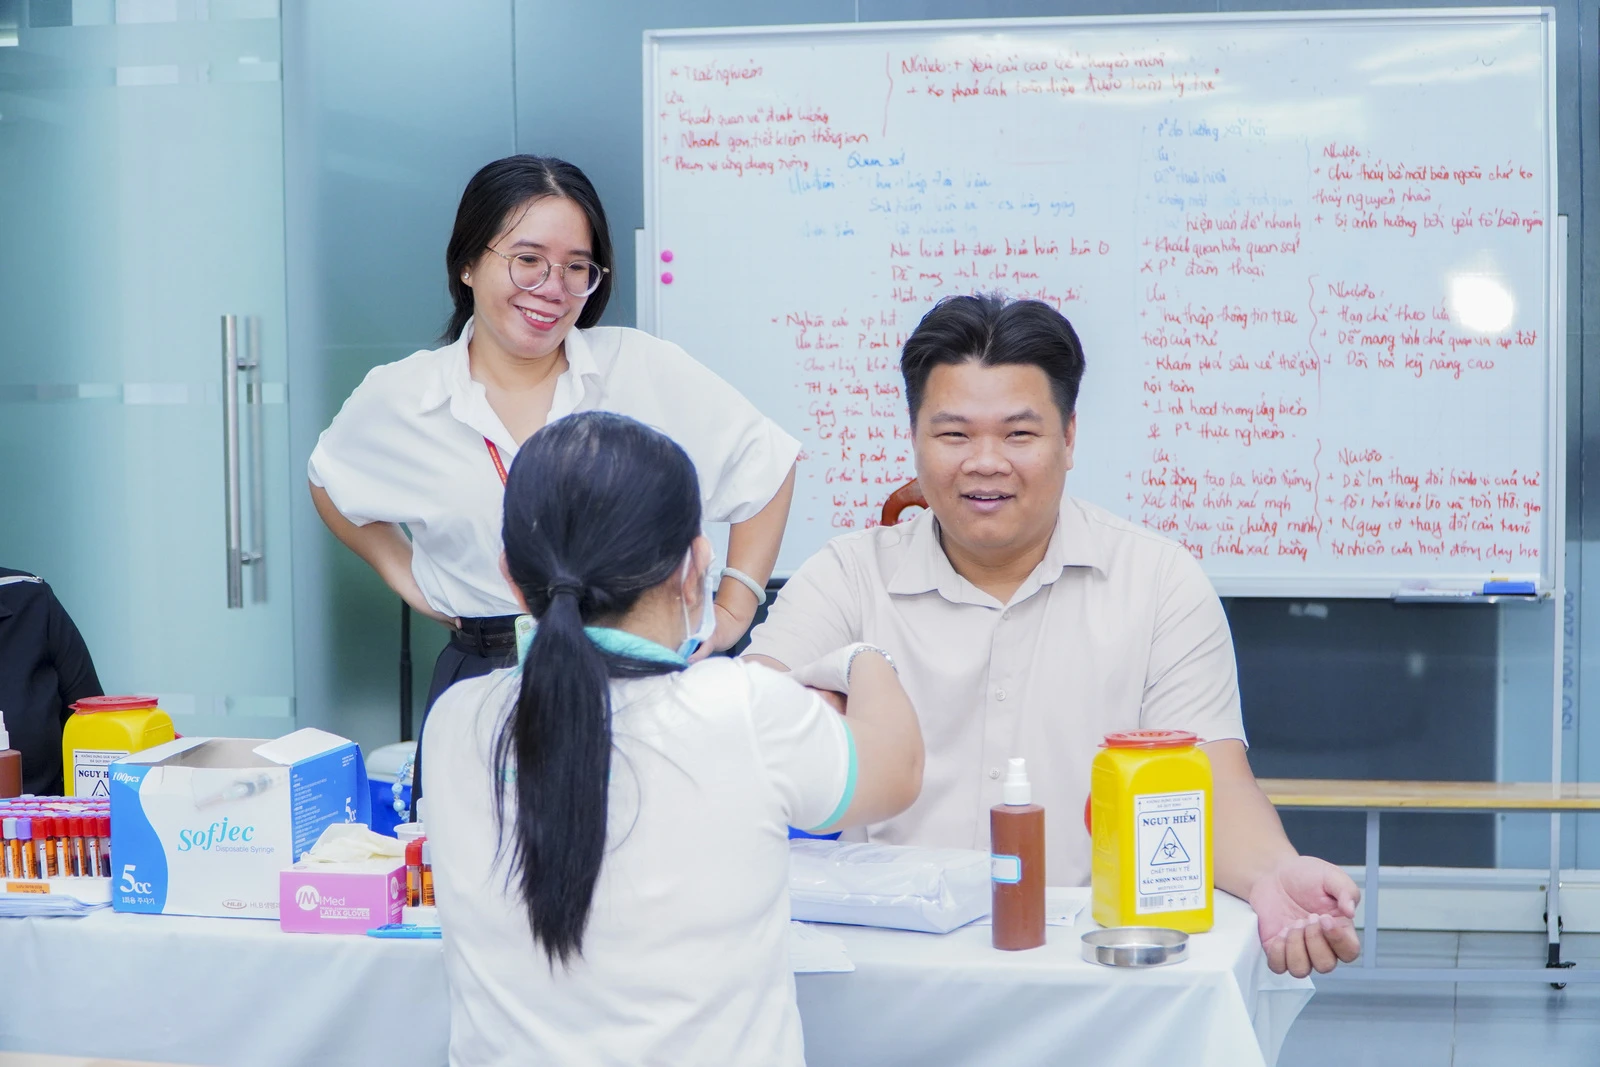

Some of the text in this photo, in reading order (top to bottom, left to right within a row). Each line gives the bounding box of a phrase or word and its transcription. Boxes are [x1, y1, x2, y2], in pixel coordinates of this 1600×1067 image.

[78, 769, 101, 780] NGUY
[112, 771, 141, 785] 100pcs
[1142, 810, 1197, 827] NGUY HIỂM
[177, 817, 255, 852] Sofjec
[215, 845, 275, 855] Disposable Syringe
[120, 864, 153, 895] 5cc
